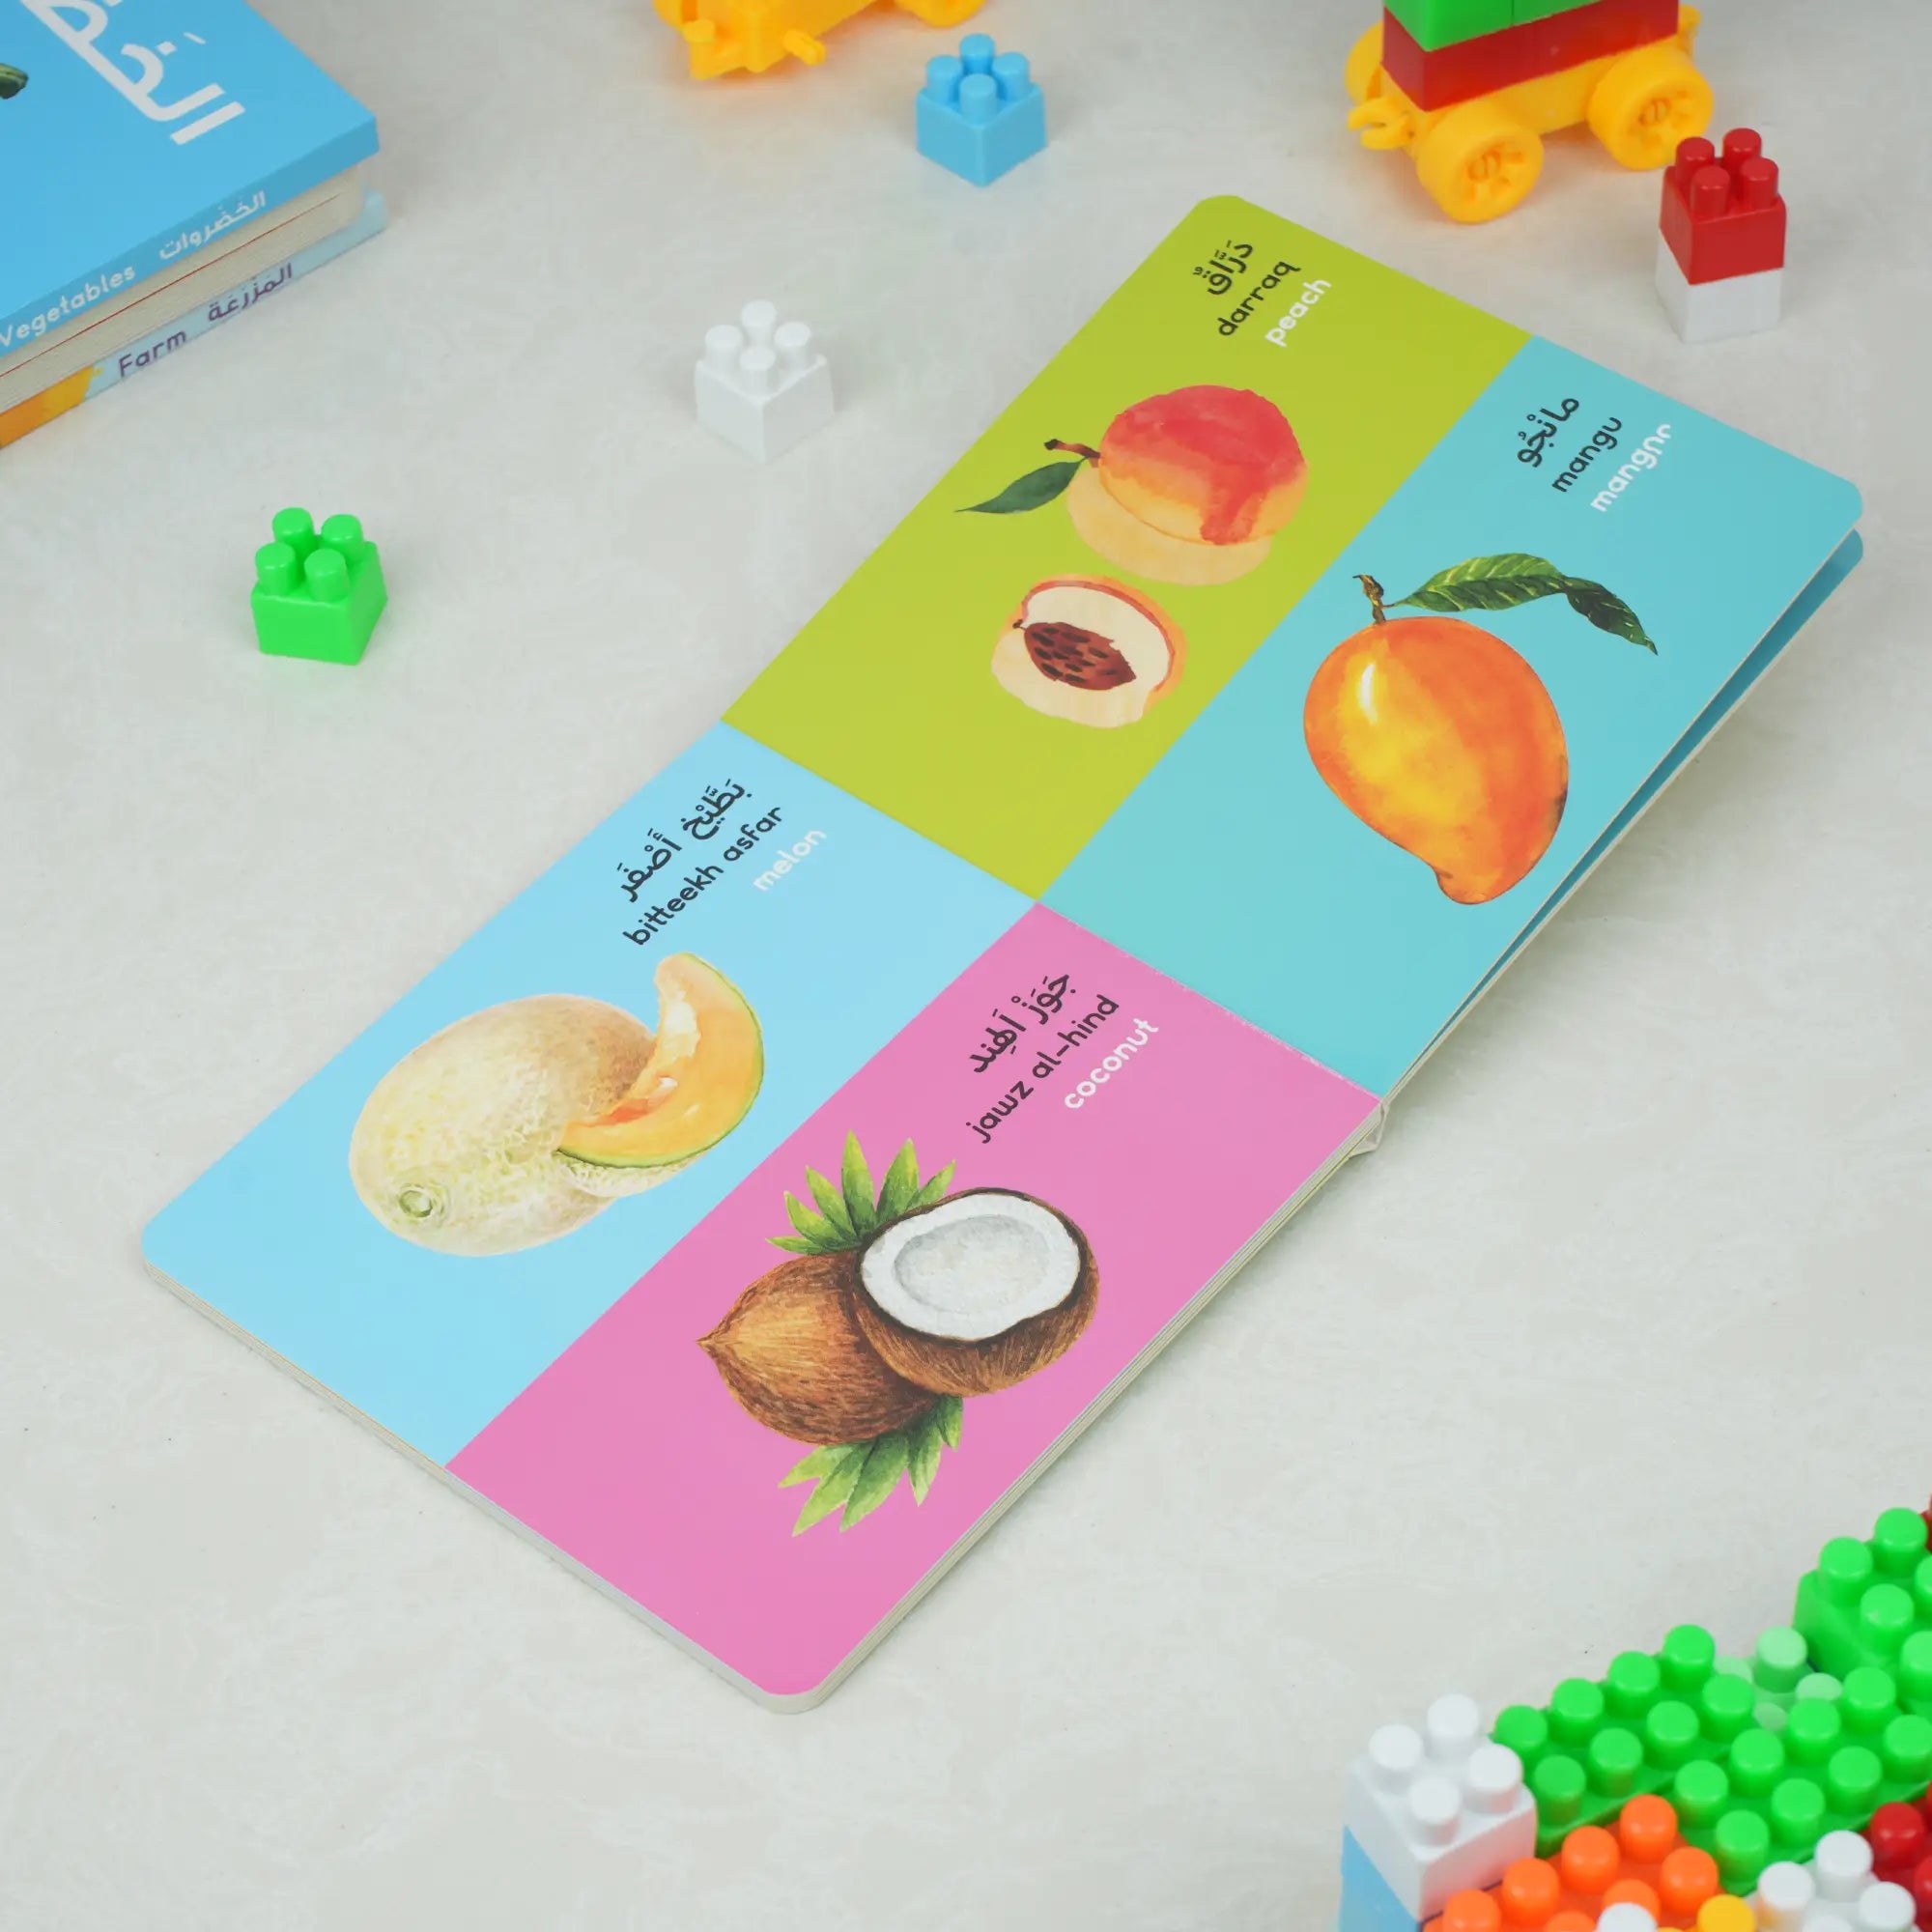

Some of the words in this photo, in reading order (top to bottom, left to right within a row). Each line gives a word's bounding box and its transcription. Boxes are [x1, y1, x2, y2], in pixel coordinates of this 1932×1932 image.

[0, 266, 136, 348] Vegetables
[1217, 261, 1302, 336] darraq
[1264, 279, 1332, 348] peach
[119, 330, 186, 379] Farm
[1551, 416, 1623, 493] mangu
[622, 865, 724, 945] bitteekh
[723, 807, 782, 862] asfar
[753, 829, 828, 892] melon
[965, 1080, 1035, 1144] jawz
[1032, 994, 1120, 1078] al-hind
[1065, 1018, 1159, 1109] coconut
